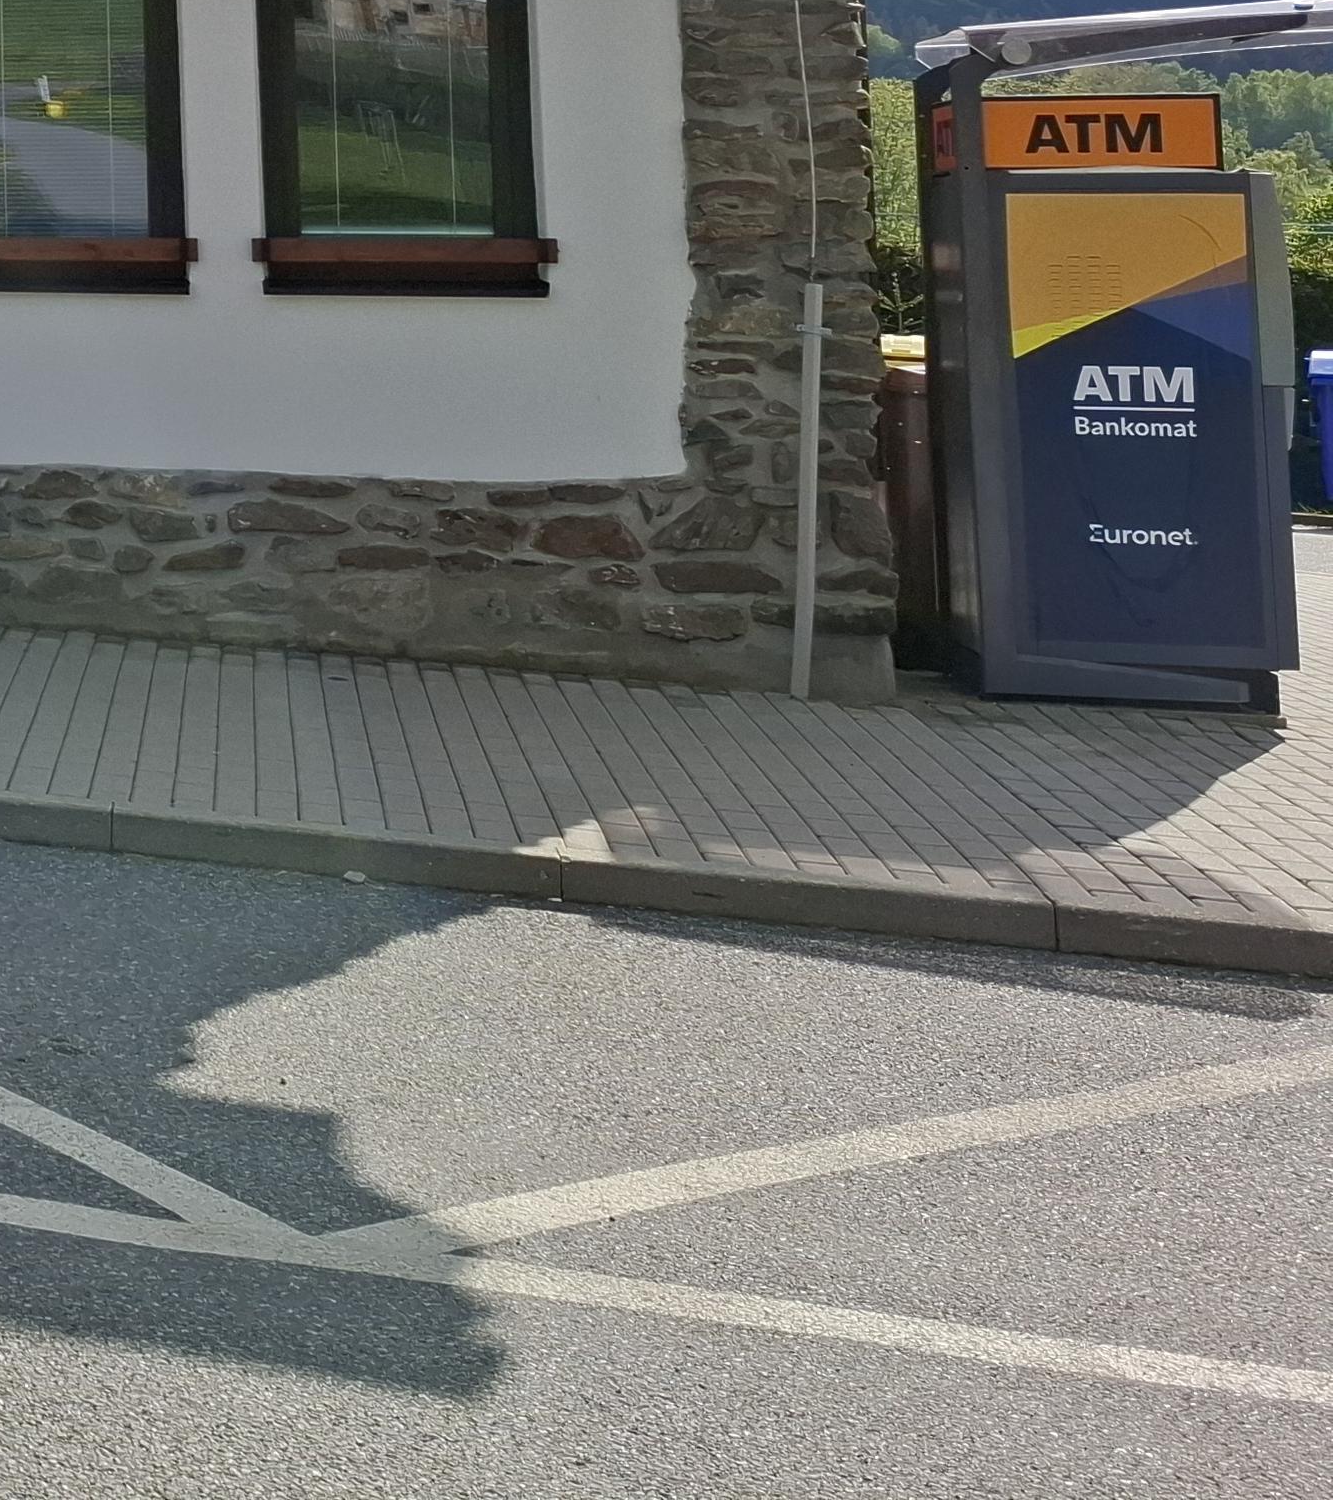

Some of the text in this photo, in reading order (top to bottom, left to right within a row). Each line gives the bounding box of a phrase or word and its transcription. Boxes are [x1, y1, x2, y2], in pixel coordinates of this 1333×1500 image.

[1025, 112, 1164, 154] ATM
[1073, 365, 1195, 403] ATM
[1074, 416, 1198, 438] Bankomat
